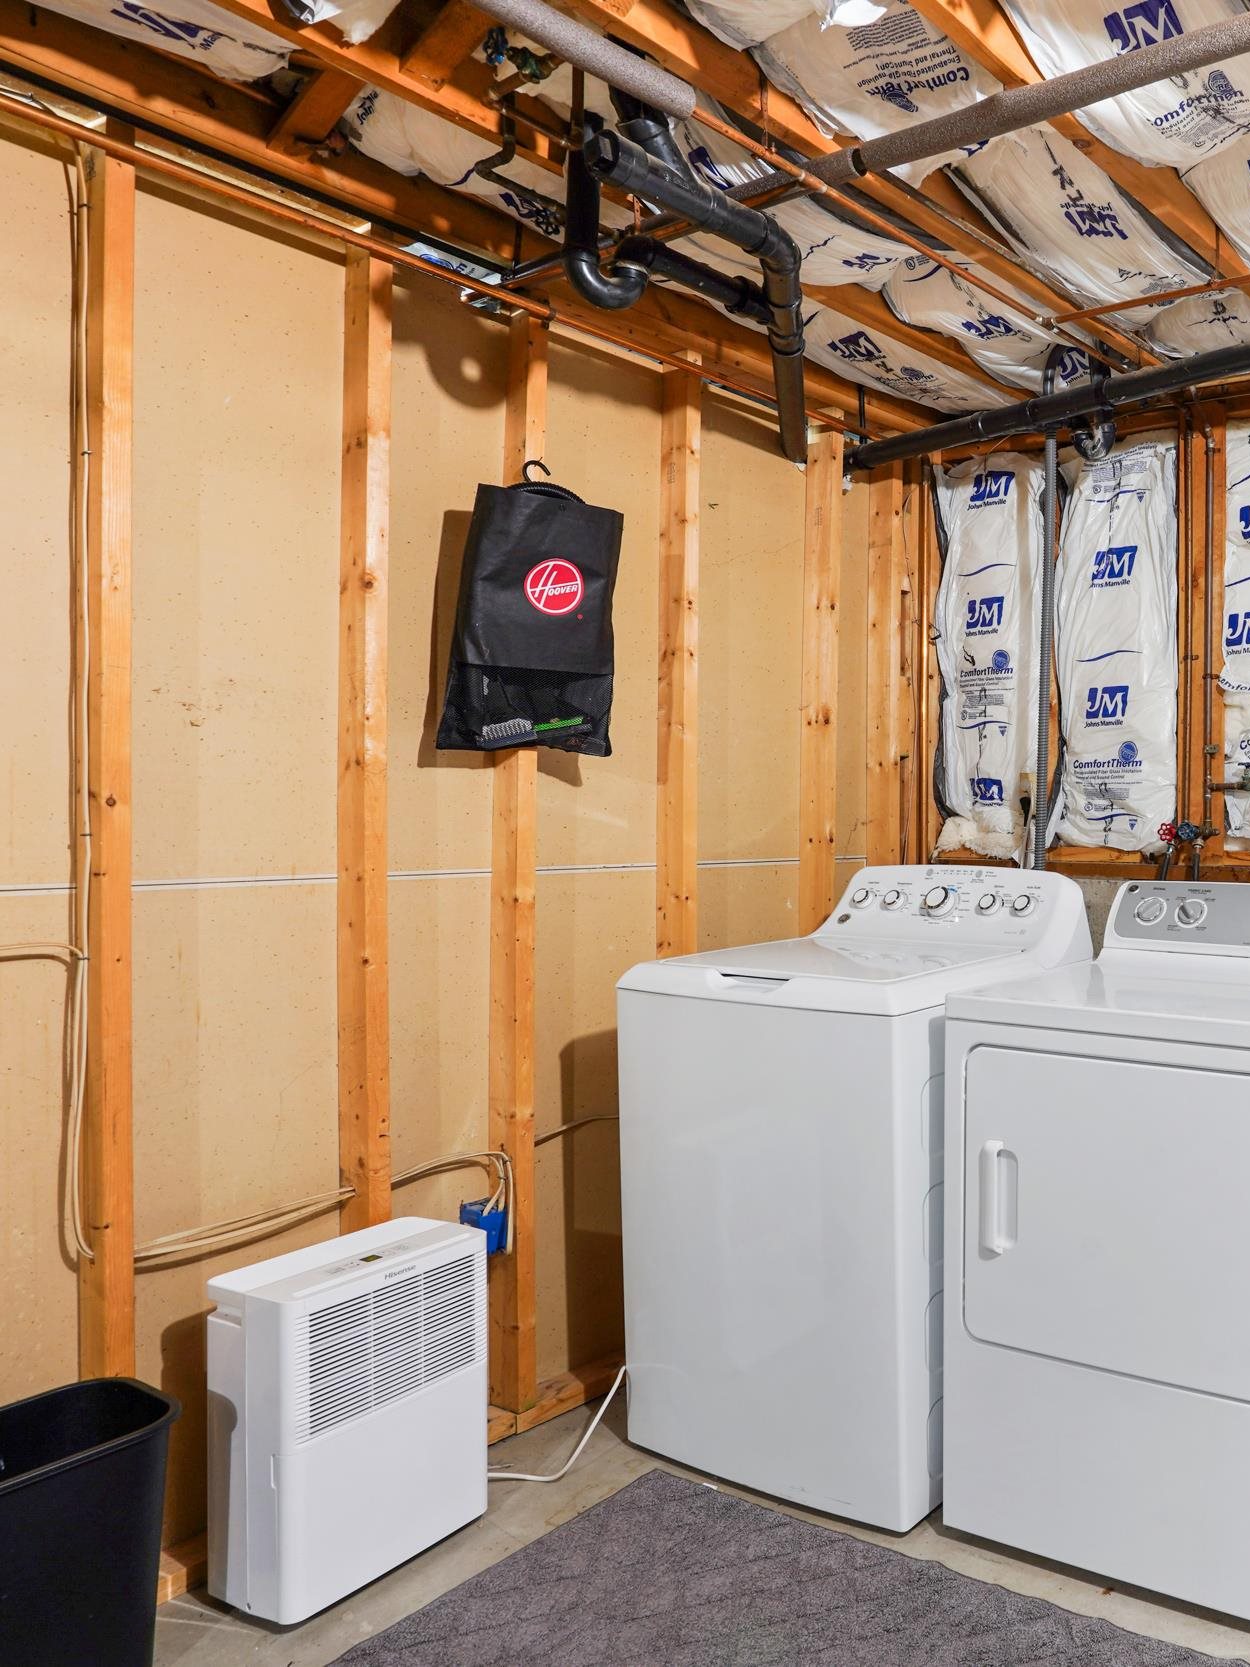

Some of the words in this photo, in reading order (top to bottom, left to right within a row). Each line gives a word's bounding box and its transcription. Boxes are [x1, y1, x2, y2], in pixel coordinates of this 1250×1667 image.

[1104, 0, 1184, 57] JM
[915, 55, 929, 64] and
[970, 470, 1016, 502] JM
[1092, 545, 1138, 580] JM
[1104, 578, 1131, 587] Manville
[966, 596, 1005, 629] JM
[977, 628, 999, 637] Manville
[1226, 646, 1243, 657] Johns
[959, 667, 1014, 679] ComfortTherm
[1085, 685, 1129, 719] JM
[1084, 720, 1100, 729] Johns
[1099, 719, 1124, 728] Manville
[1073, 758, 1143, 770] ComfortTherm
